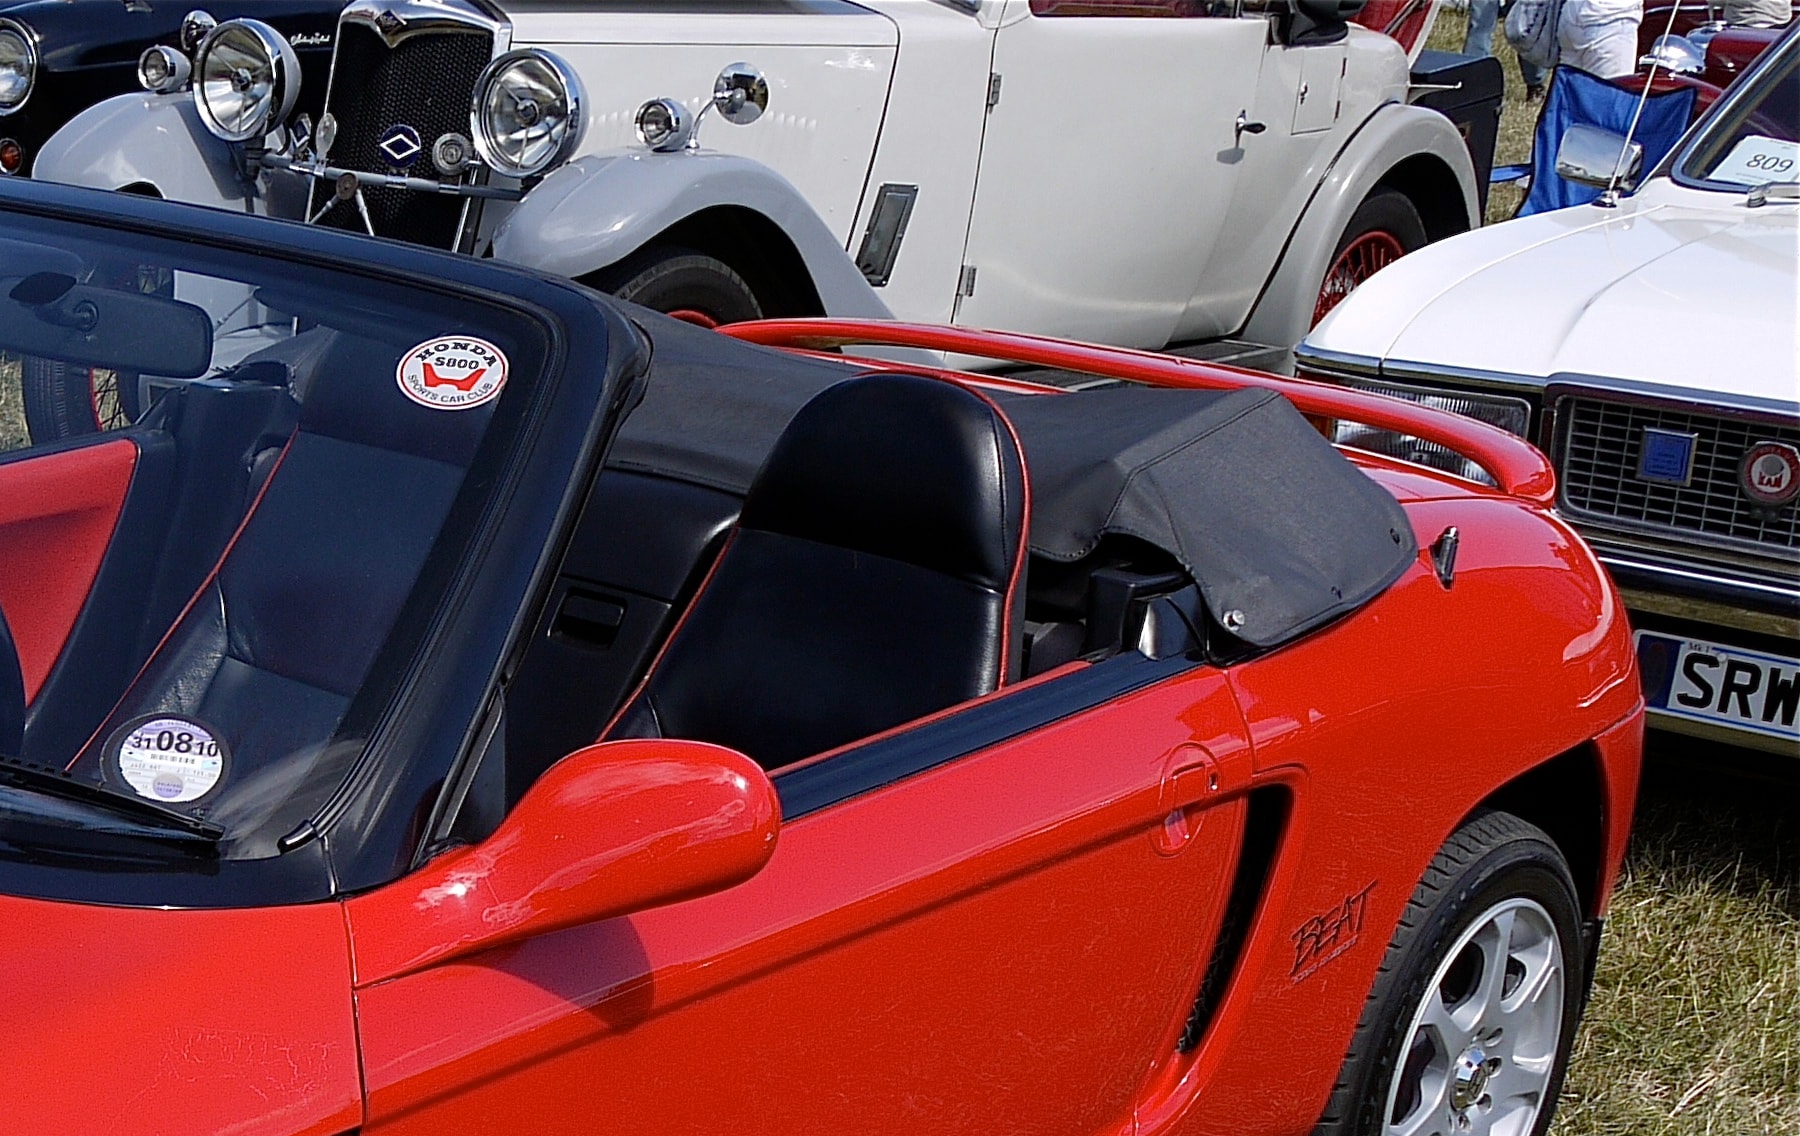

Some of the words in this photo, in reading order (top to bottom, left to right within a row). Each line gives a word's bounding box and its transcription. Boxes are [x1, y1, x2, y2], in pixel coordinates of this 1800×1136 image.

[1746, 154, 1794, 173] 809
[415, 342, 497, 368] HONDA
[434, 356, 479, 370] S800
[408, 374, 439, 401] SPORTS
[440, 395, 465, 403] CAR
[467, 382, 493, 400] CLUB
[1677, 652, 1800, 727] SRW
[131, 736, 152, 750] 31
[156, 730, 194, 754] 08
[196, 741, 218, 757] 10
[1289, 879, 1378, 976] BEAT
